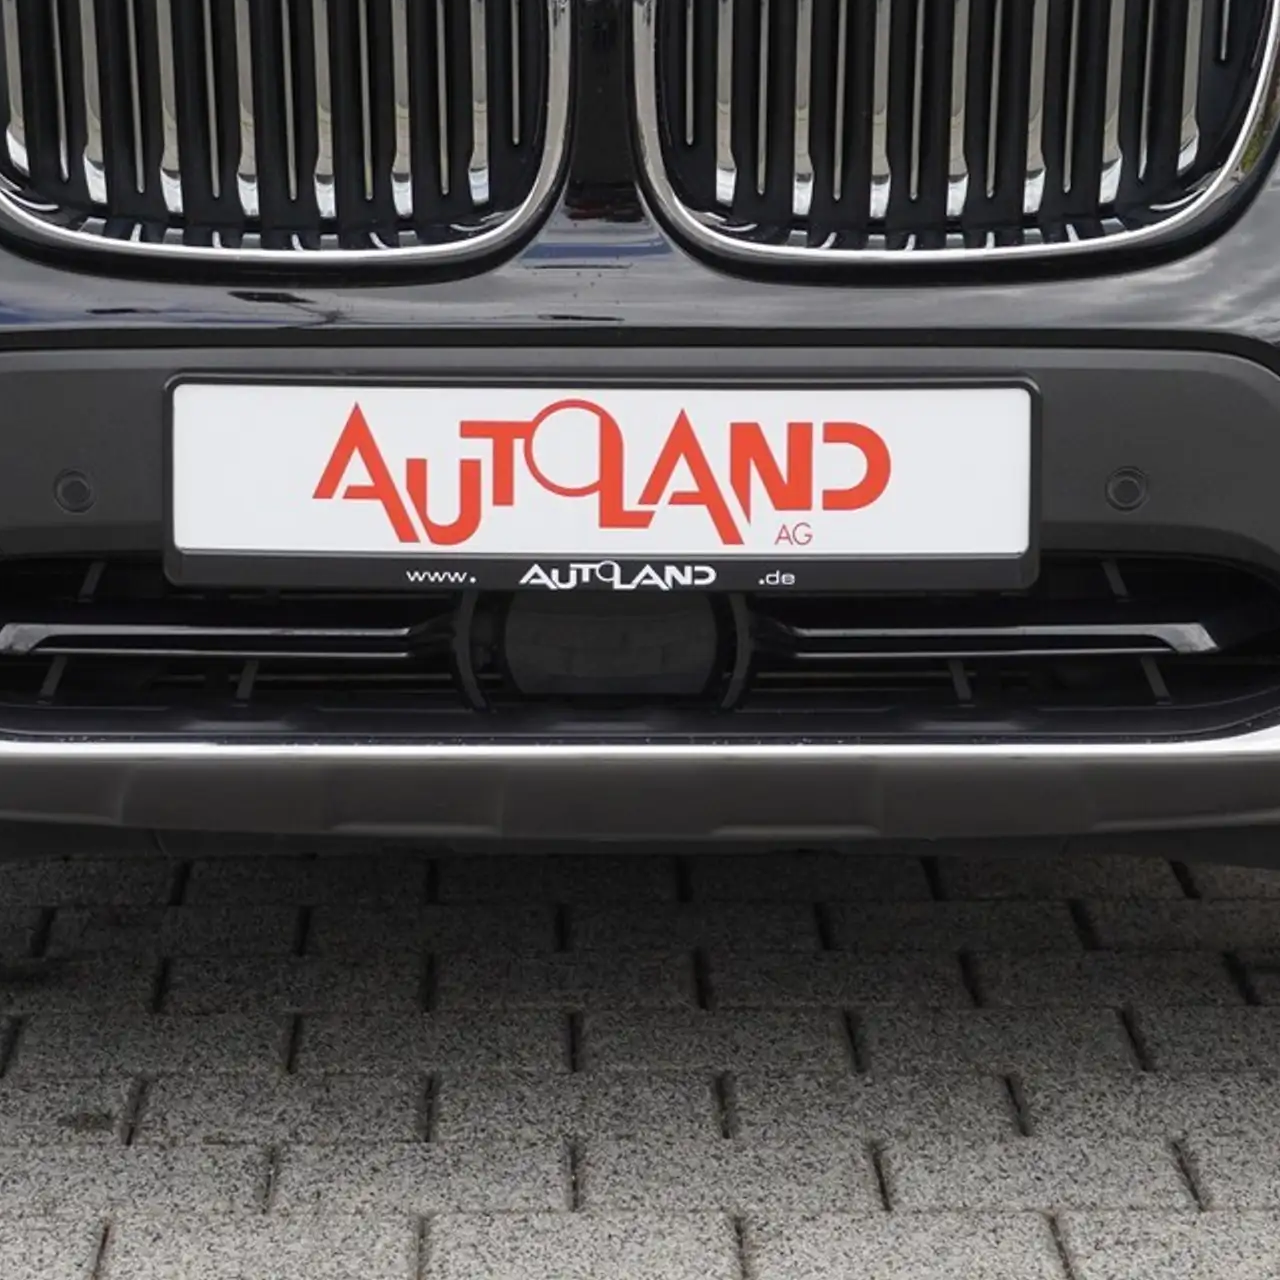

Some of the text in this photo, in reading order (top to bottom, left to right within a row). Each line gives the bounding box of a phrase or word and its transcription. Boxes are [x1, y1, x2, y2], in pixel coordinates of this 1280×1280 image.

[314, 398, 892, 546] AUTOLAND
[775, 522, 813, 545] AG
[405, 560, 796, 591] www. AUTOLAND .de
